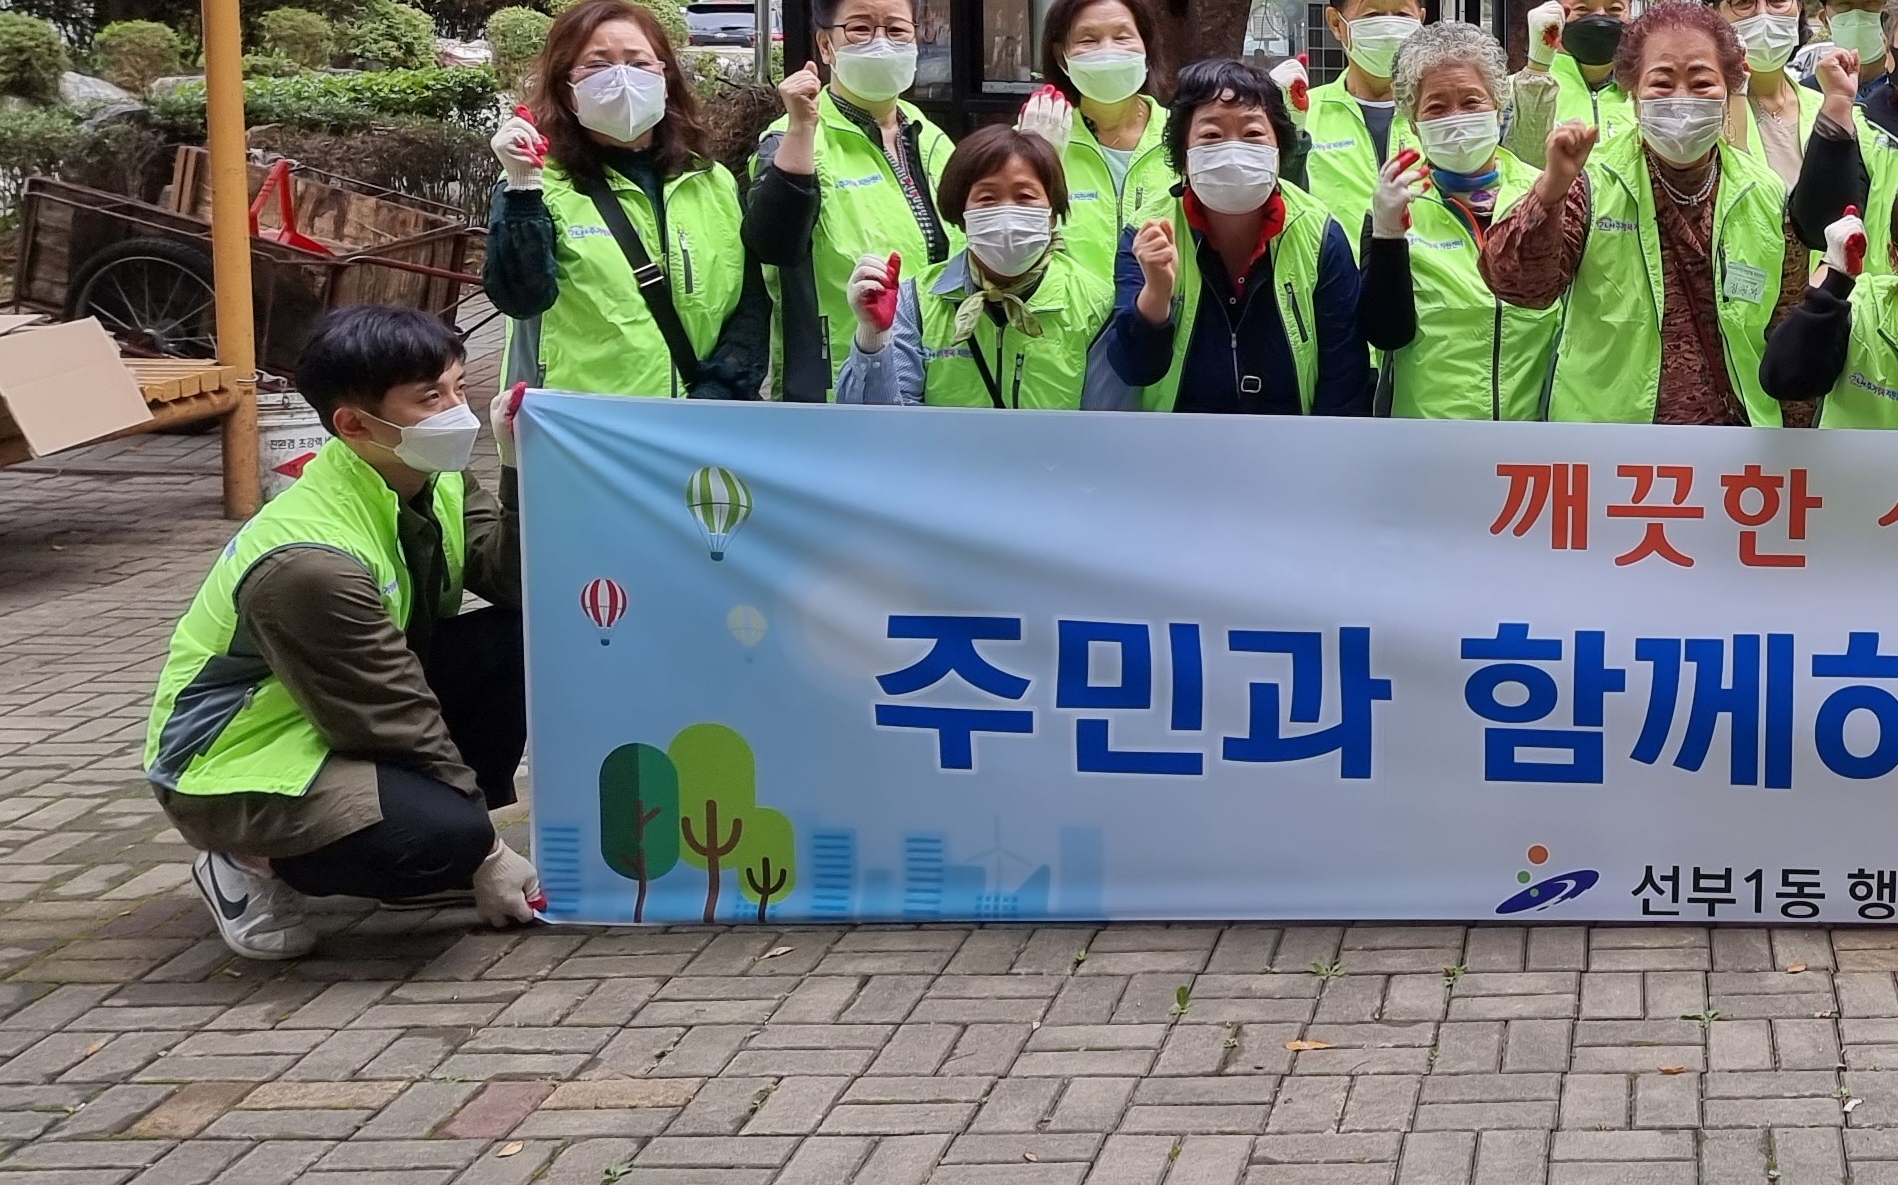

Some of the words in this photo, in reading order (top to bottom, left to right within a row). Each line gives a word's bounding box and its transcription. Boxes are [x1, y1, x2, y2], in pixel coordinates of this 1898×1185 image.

[1488, 462, 1824, 568] 깨끗한
[874, 614, 1394, 780] 주민과
[1630, 863, 1827, 917] 선부1동
